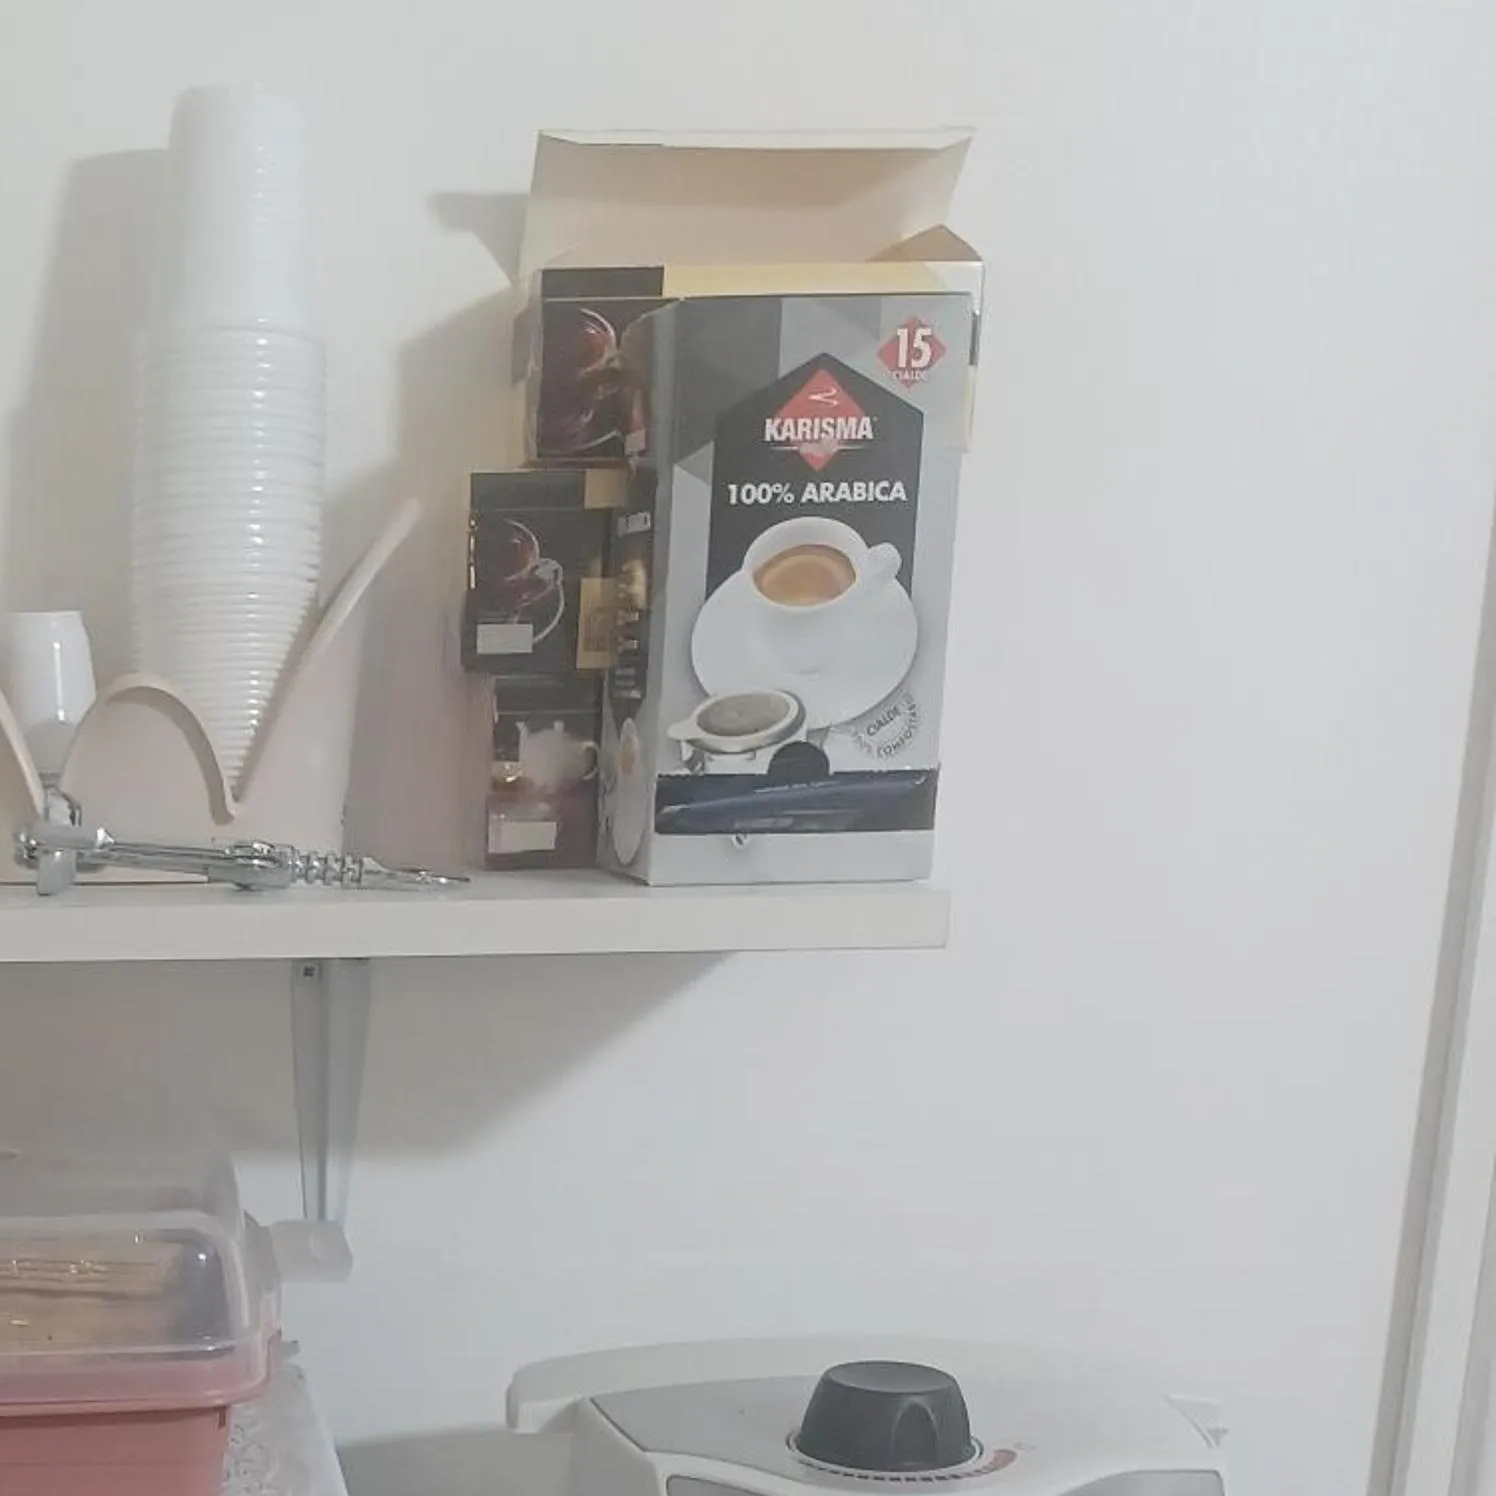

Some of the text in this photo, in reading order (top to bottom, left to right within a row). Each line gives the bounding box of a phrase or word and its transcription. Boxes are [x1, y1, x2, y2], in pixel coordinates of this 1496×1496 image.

[896, 327, 932, 368] 15
[764, 416, 873, 441] KARISMA
[728, 481, 907, 505] 100% ARABICA
